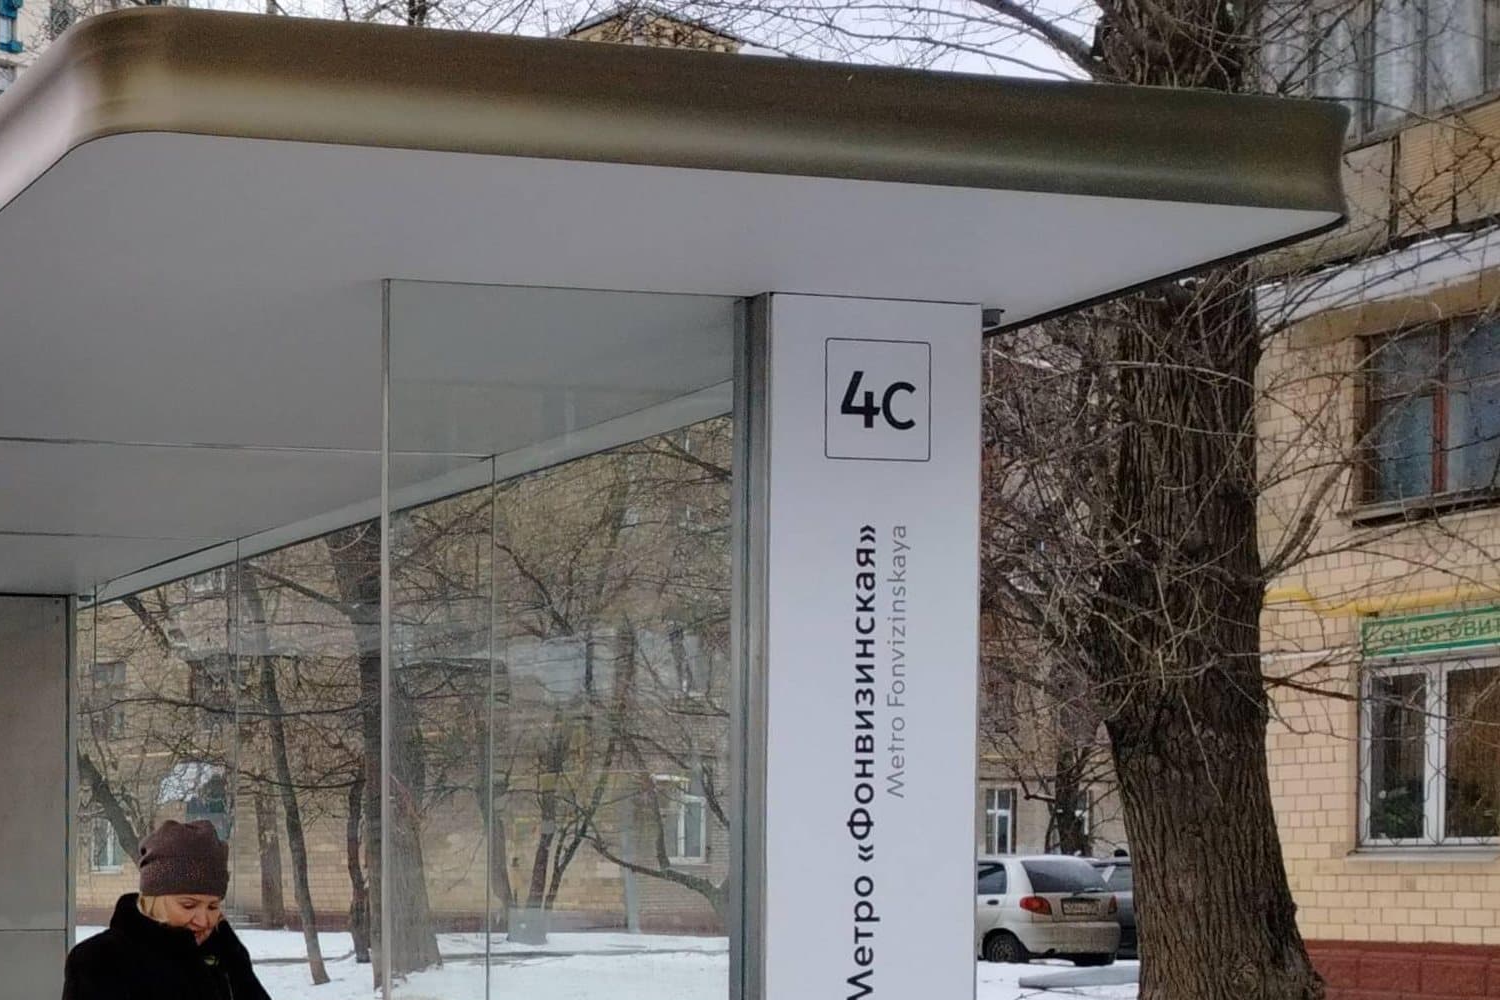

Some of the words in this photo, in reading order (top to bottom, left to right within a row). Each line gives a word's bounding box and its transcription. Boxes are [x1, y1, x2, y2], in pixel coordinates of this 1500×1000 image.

[846, 524, 876, 862] «Фонвизинская»
[886, 524, 911, 707] Fonvizinskaya
[885, 716, 906, 799] Metro
